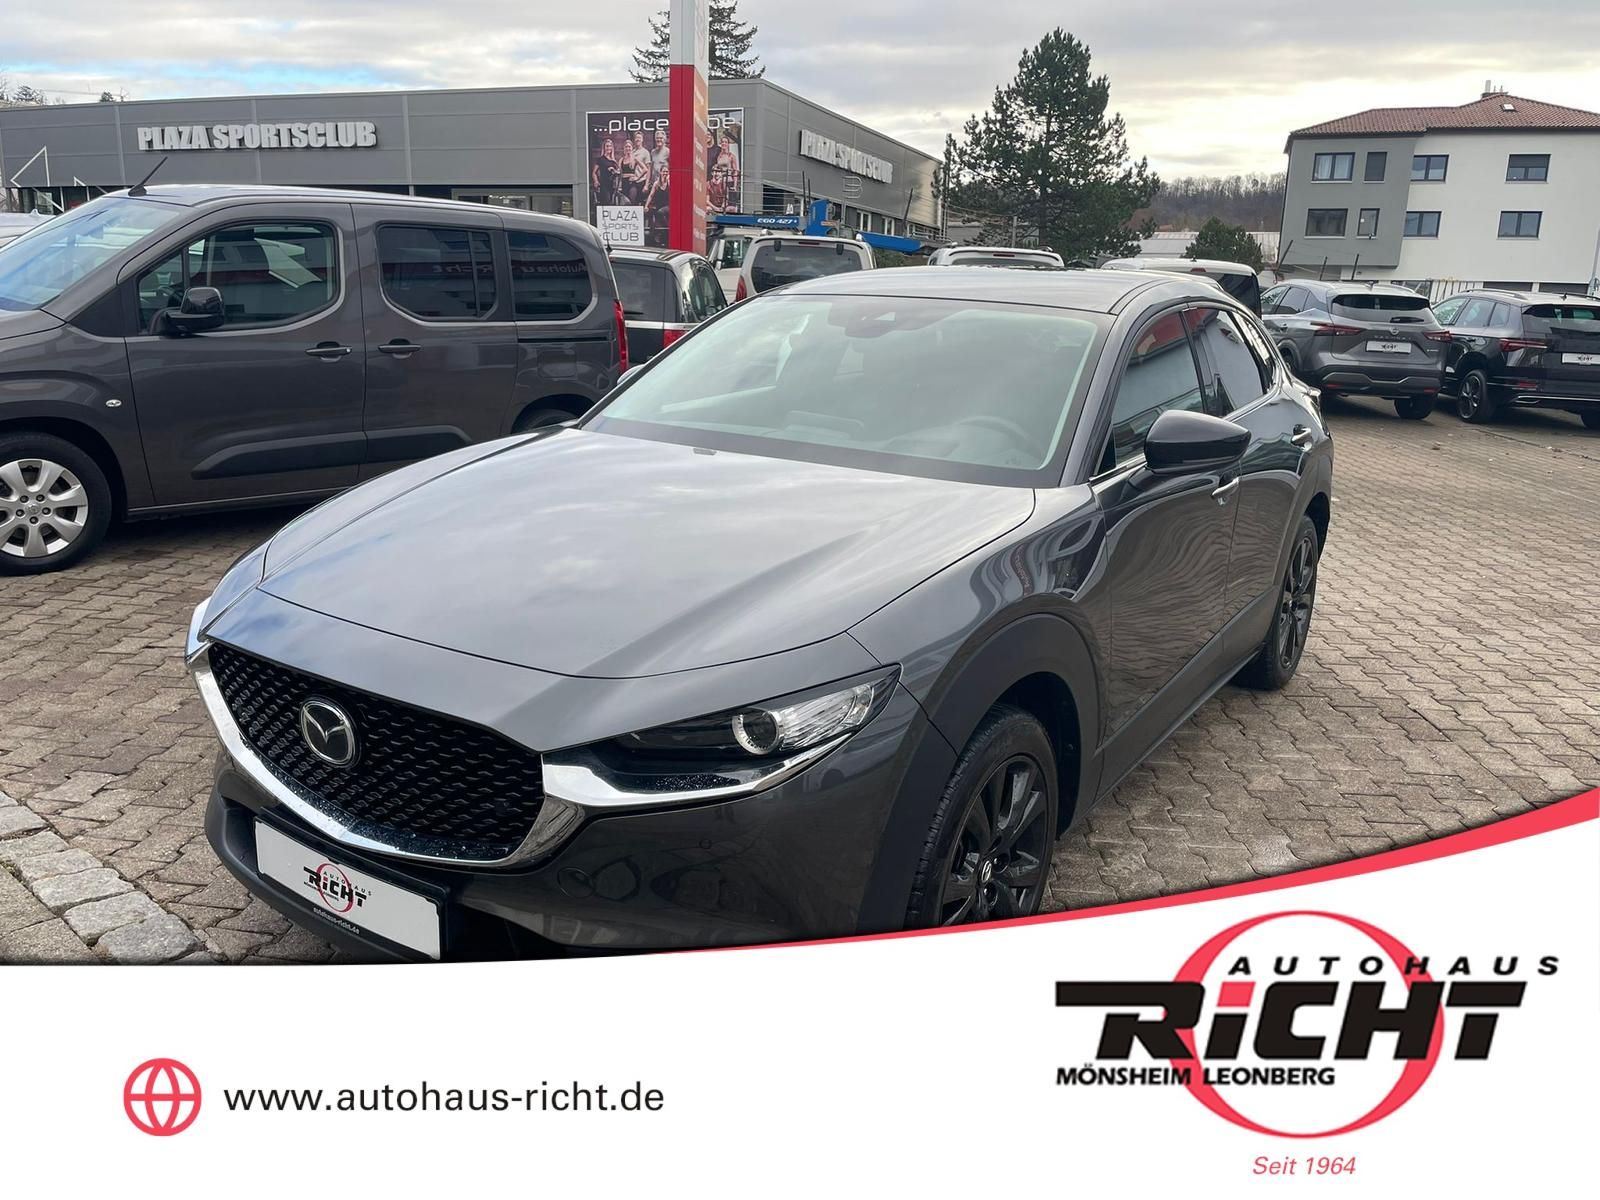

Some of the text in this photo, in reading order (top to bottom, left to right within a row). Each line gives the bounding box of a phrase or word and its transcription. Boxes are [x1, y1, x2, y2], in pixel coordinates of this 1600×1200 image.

[137, 122, 378, 150] PLAZA SPORTSCLUB
[602, 210, 639, 221] PLAZA
[602, 231, 640, 241] CLUB
